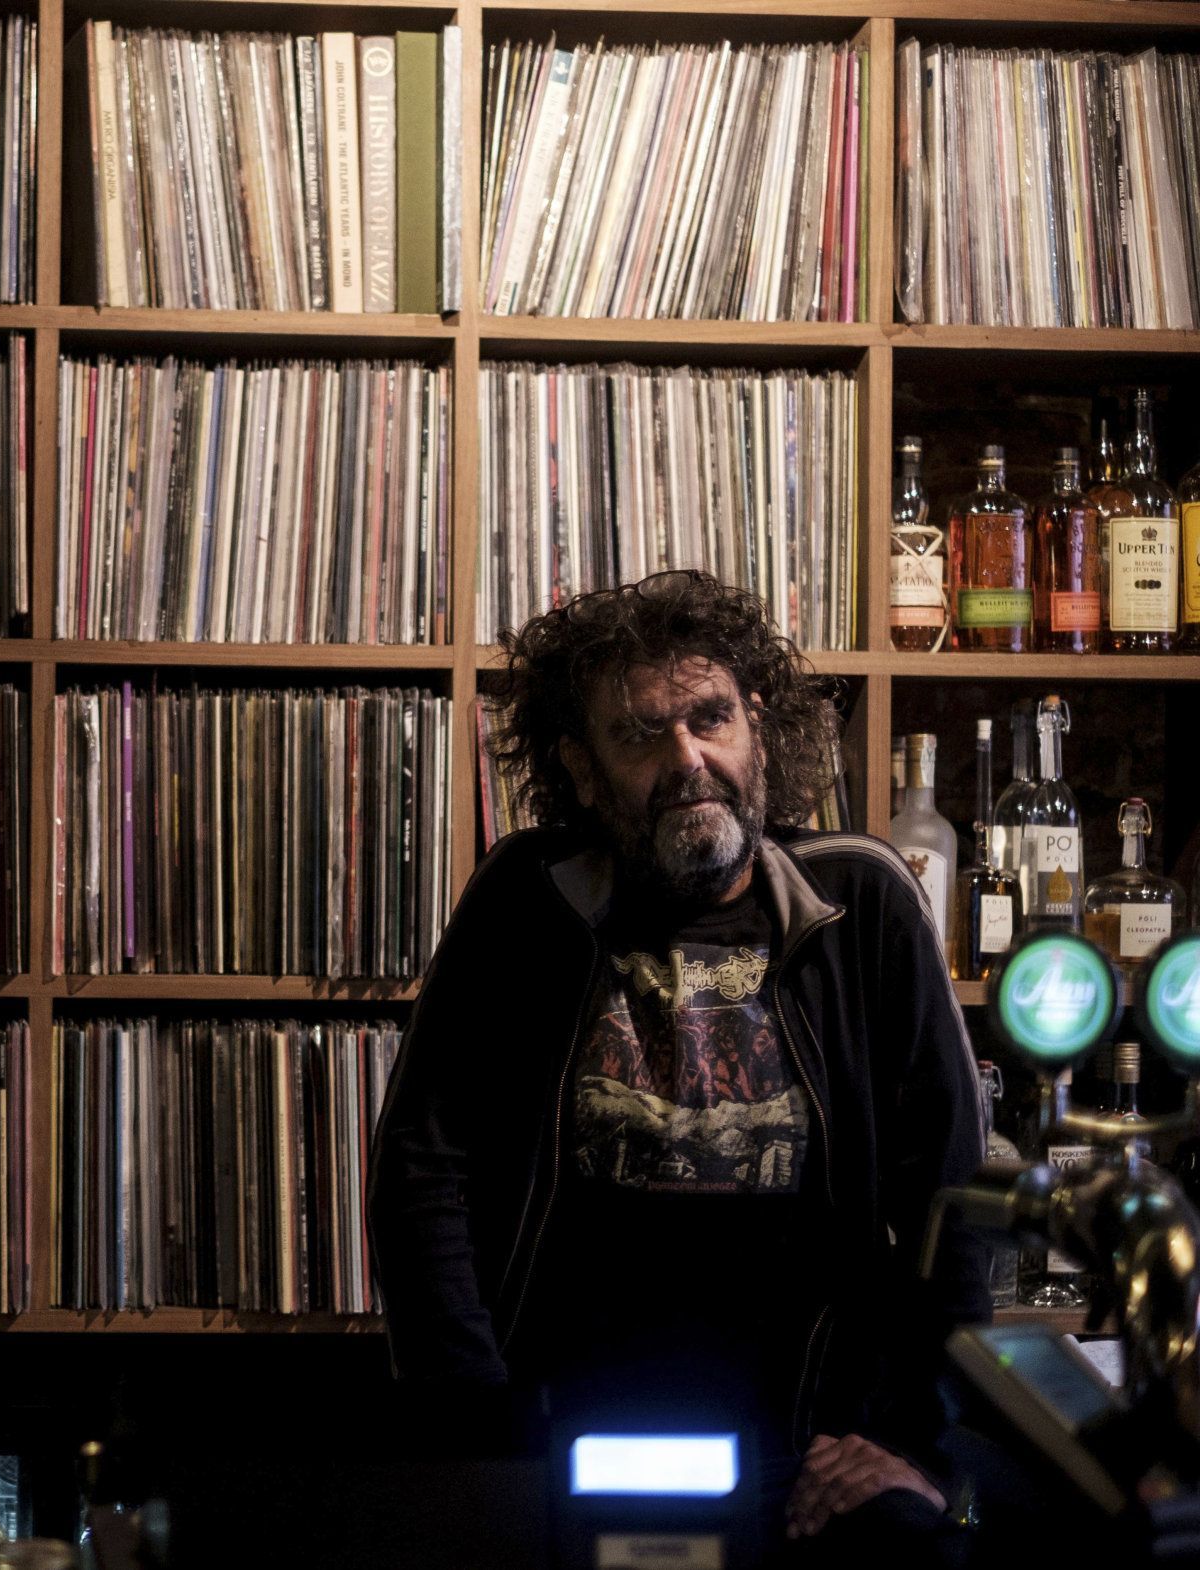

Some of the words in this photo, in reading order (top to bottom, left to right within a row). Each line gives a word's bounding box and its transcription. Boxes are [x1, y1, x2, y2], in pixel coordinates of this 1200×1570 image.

[334, 60, 345, 85] JOHN
[335, 86, 348, 132] COLTRANE
[337, 141, 348, 157] THE
[368, 94, 390, 197] HISTORY
[337, 159, 350, 205] ATLANTIC
[338, 207, 351, 238] YEARS
[369, 206, 390, 242] OF
[340, 248, 351, 260] IN
[341, 260, 353, 289] MONO
[369, 243, 391, 303] JAZZ
[1118, 541, 1156, 556] UPPER
[1045, 855, 1074, 863] POLI
[1125, 926, 1167, 934] CLEOPATRA
